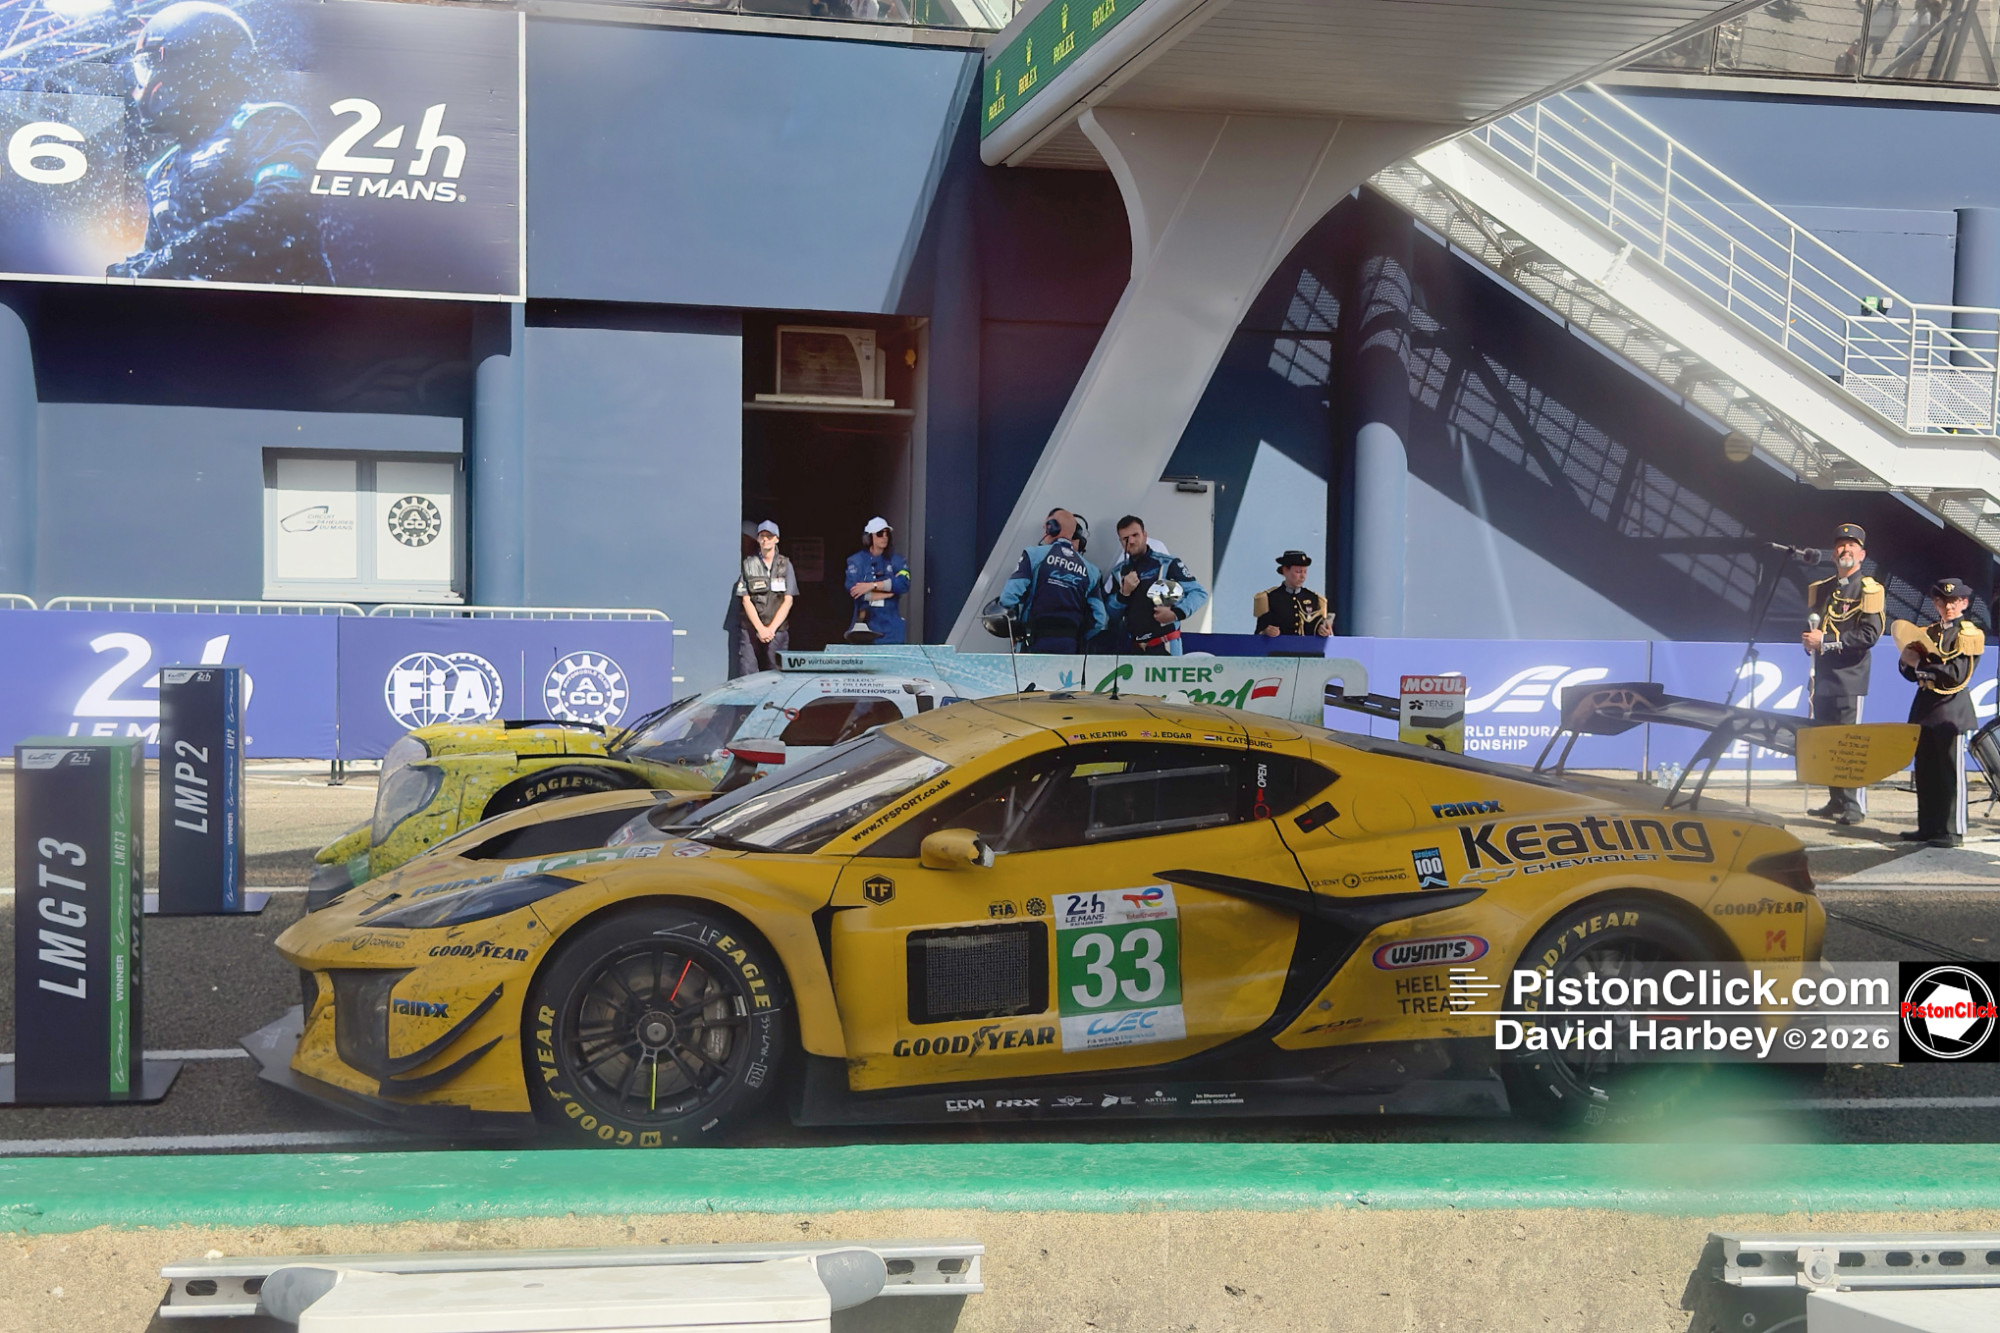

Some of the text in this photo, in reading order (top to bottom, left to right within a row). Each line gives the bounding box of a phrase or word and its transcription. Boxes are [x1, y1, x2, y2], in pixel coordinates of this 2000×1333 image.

[1053, 31, 1076, 66] ROLEX
[1018, 65, 1038, 96] ROLEX
[315, 97, 468, 179] 24h
[7, 121, 89, 184] 6
[310, 175, 350, 196] LE
[1046, 554, 1088, 578] OFFICIAL
[808, 658, 864, 666] wirtualna polska
[1403, 677, 1464, 693] MOTUL
[226, 728, 235, 750] LMP2
[1079, 729, 1128, 741] B. KEATING
[1152, 730, 1192, 740] J. EDGAR
[174, 740, 209, 834] LMP2
[1256, 763, 1268, 788] OPEN
[524, 776, 583, 801] EAGLE
[851, 779, 951, 842] www.TFSPORT.co.uk
[114, 830, 127, 866] LMGT3
[1457, 814, 1716, 871] Keating
[1415, 857, 1443, 876] 100
[1523, 853, 1660, 876] CHEVROLET
[867, 883, 891, 898] TF
[1066, 893, 1106, 916] 24h
[1713, 897, 1805, 916] GOODYEAR
[38, 836, 87, 1000] LMGT3
[1065, 915, 1077, 924] LE
[1077, 913, 1105, 922] MANS
[428, 940, 529, 962] GOODYEAR
[116, 954, 125, 1002] WINNER
[716, 935, 772, 1009] EAGLE
[1071, 927, 1166, 1008] 33
[1396, 974, 1446, 995] HEEL
[1397, 996, 1470, 1015] TREAD
[892, 1025, 1057, 1058] GOODYEAR
